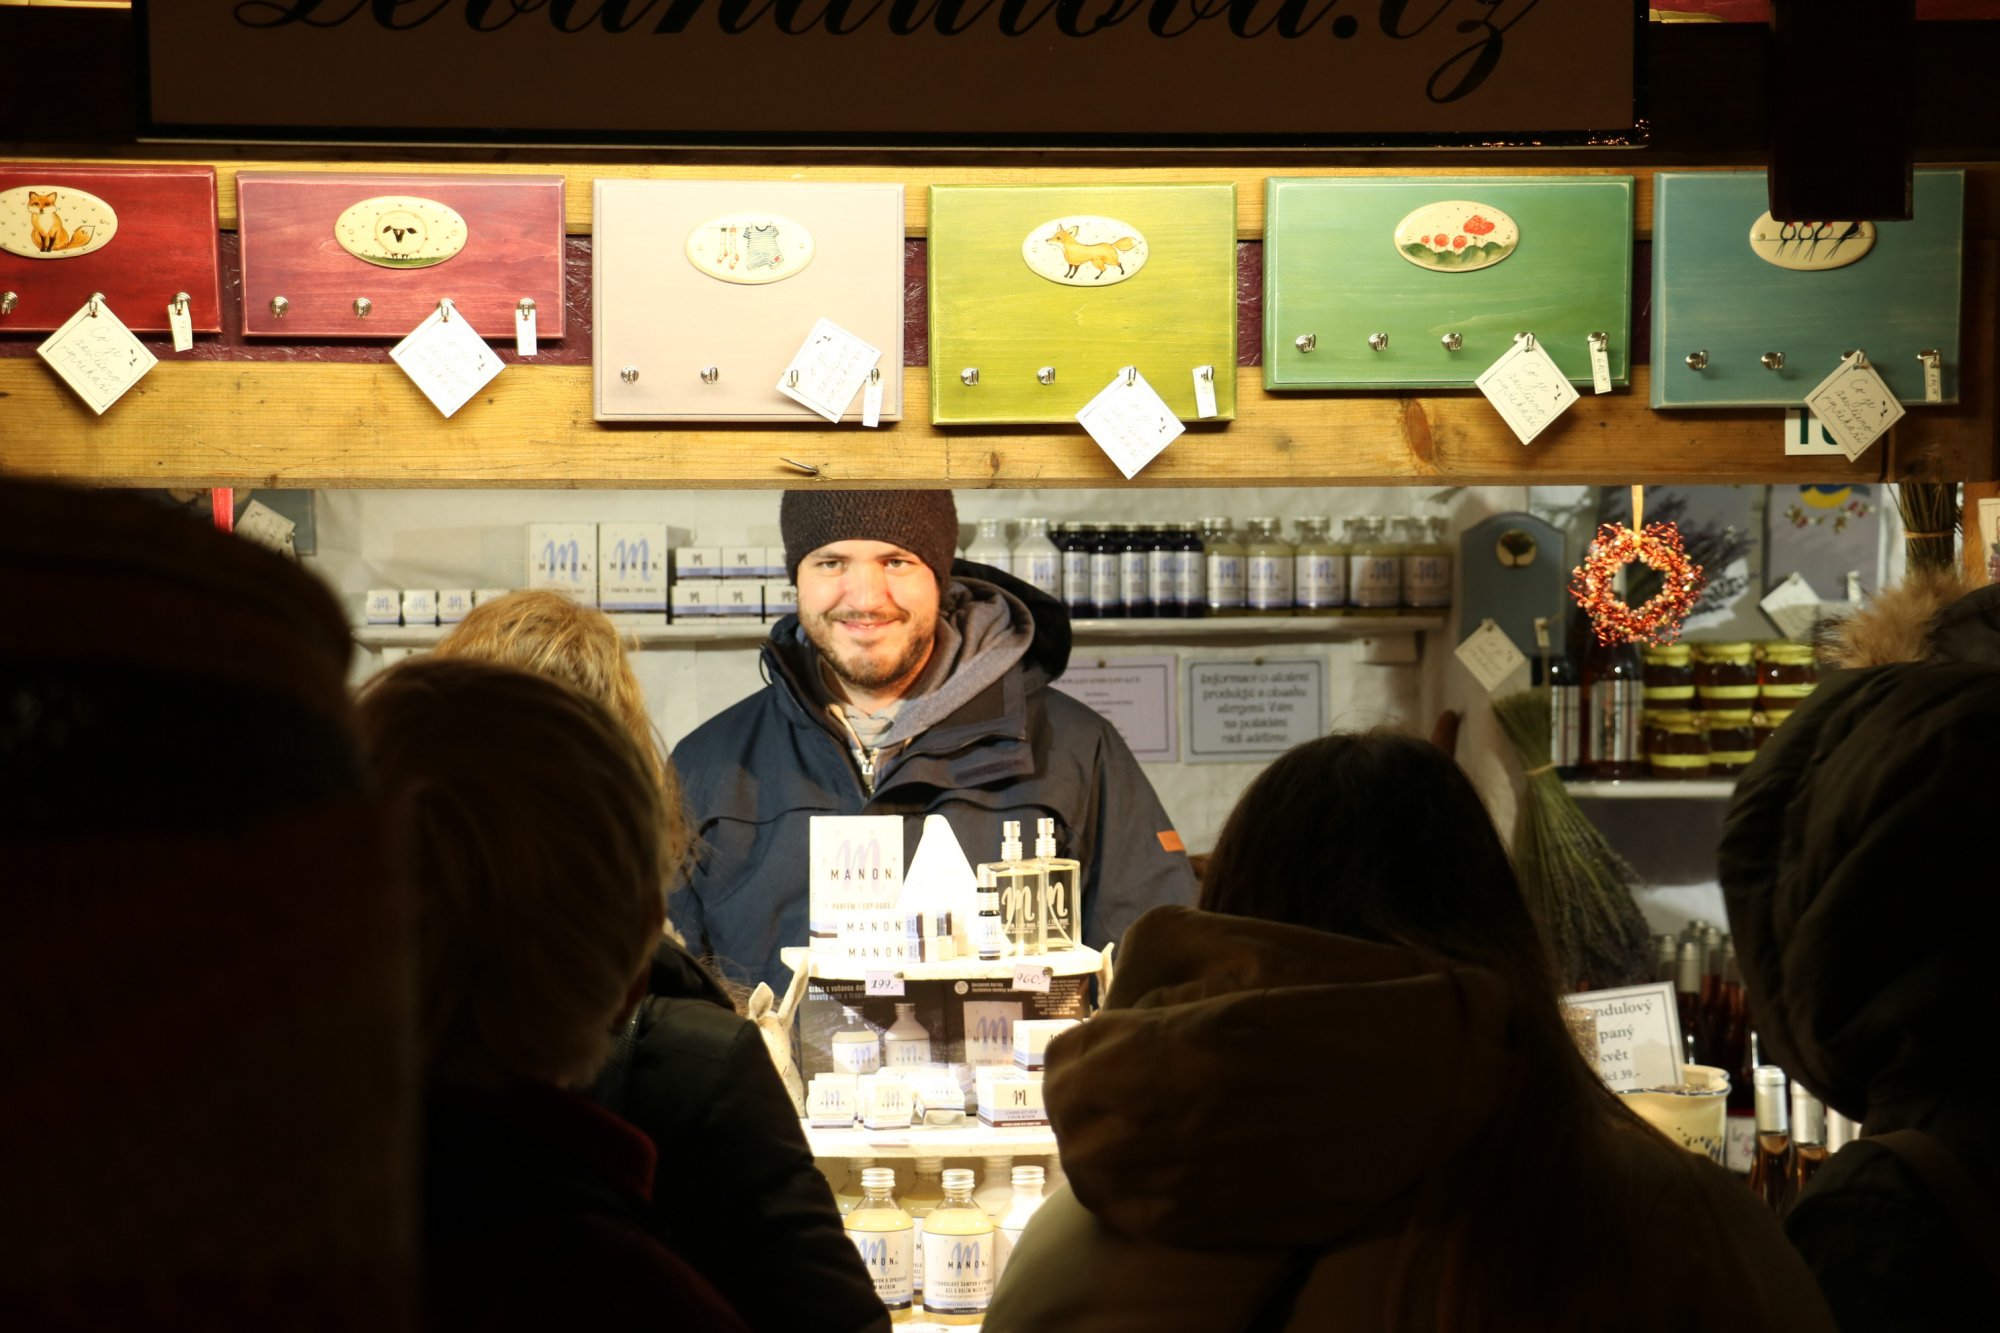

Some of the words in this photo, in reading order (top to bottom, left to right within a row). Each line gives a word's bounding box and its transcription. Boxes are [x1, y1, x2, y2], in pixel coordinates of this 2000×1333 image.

[847, 921, 901, 932] MANON
[849, 947, 903, 957] MANON
[1595, 999, 1652, 1018] ndulový
[1599, 1025, 1634, 1043] paný
